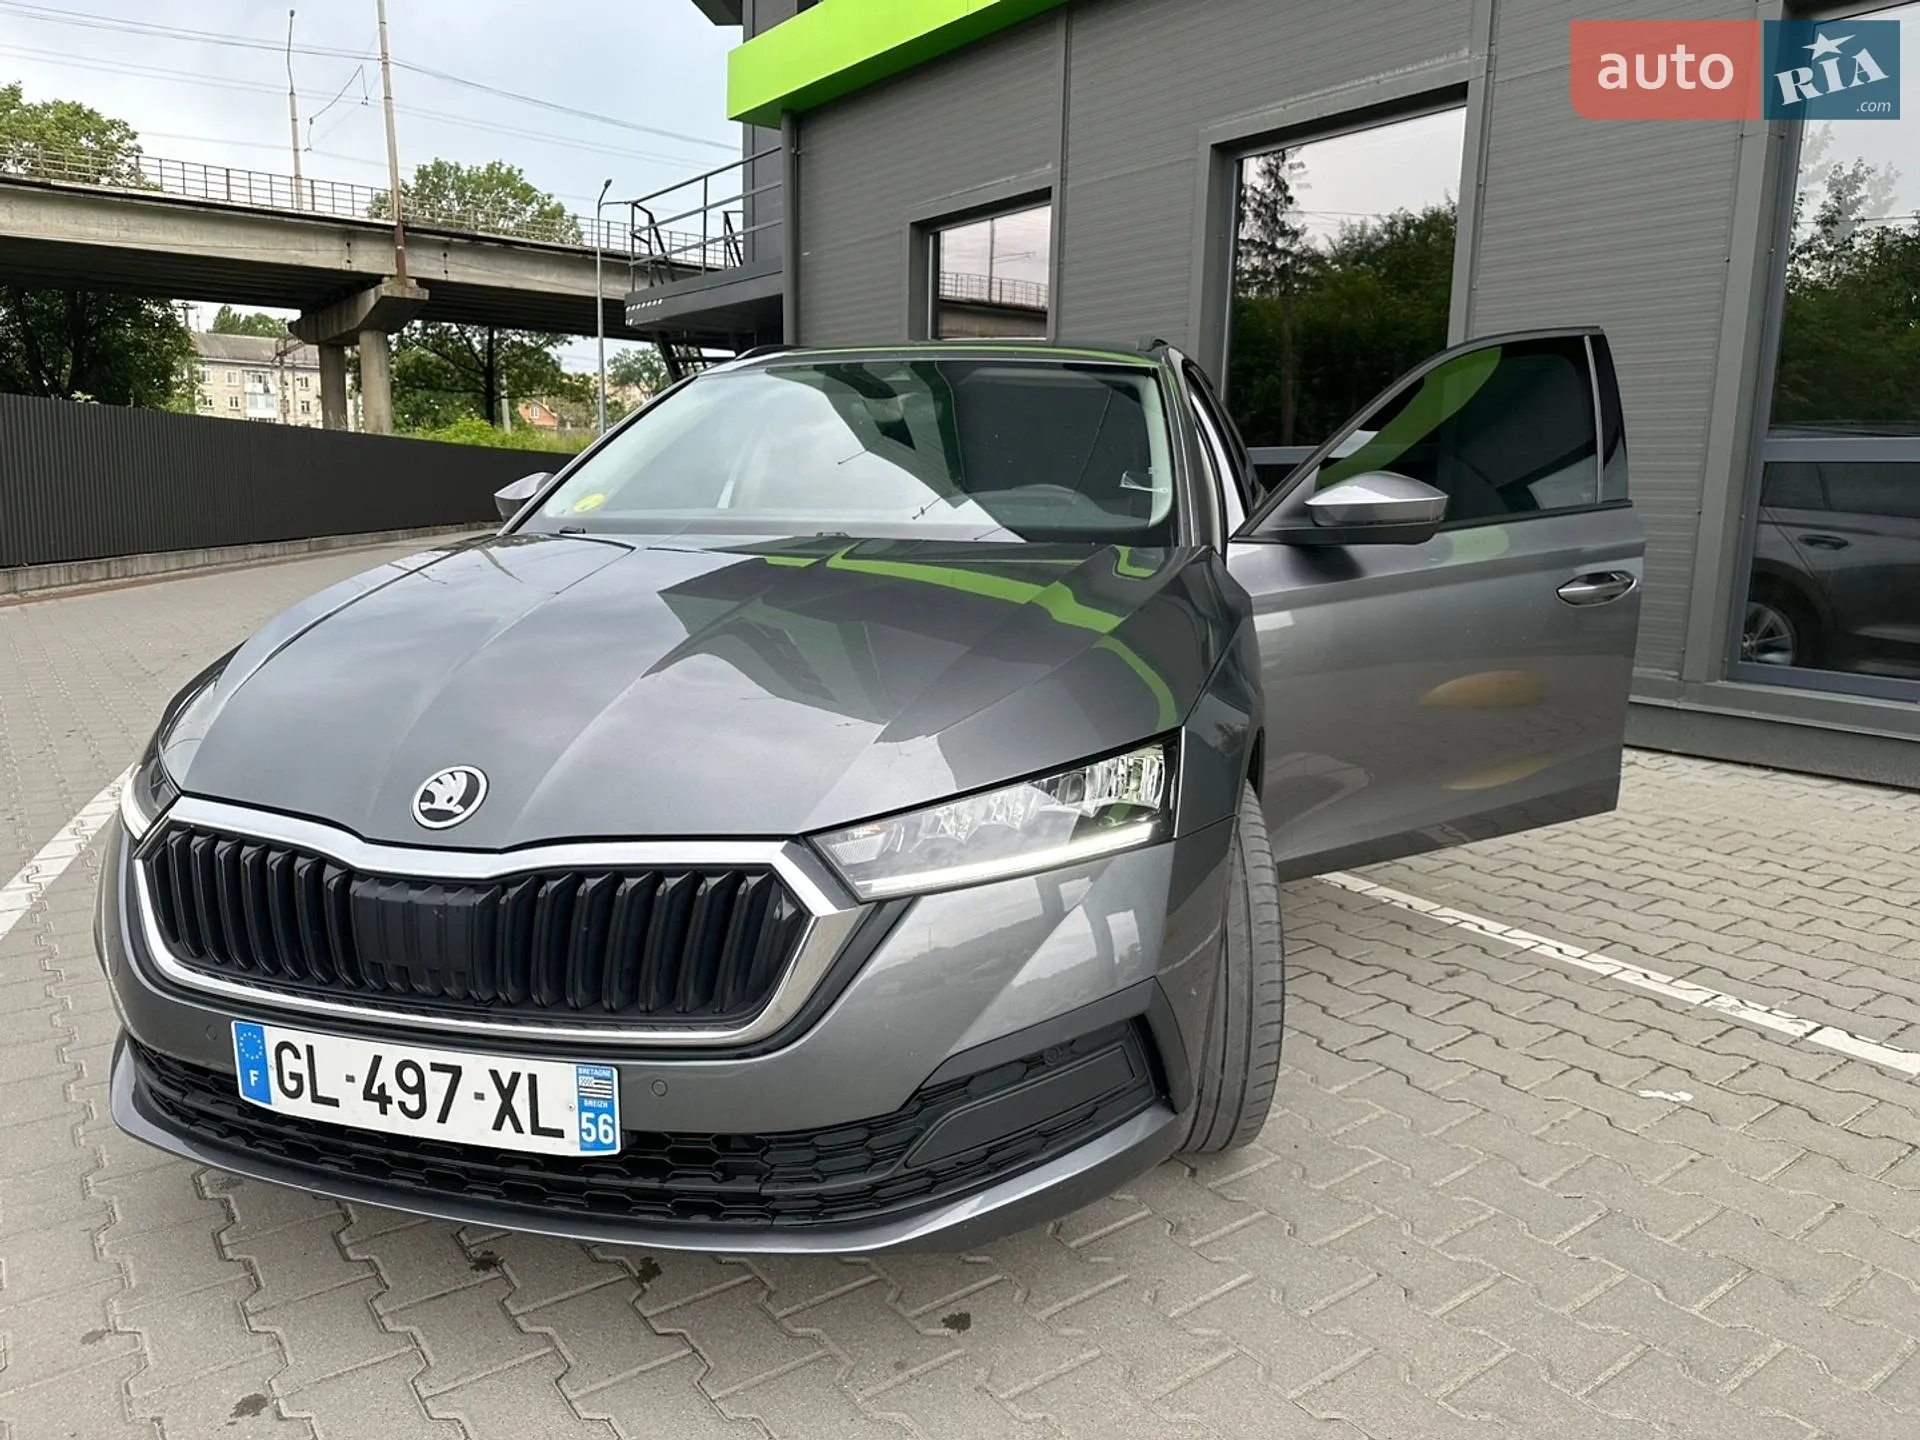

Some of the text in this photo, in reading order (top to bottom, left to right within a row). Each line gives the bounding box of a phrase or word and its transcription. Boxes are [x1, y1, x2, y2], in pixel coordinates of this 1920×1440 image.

[248, 1069, 259, 1088] F
[578, 1067, 612, 1077] BRETAGNE
[274, 1040, 565, 1139] GL-497-XL
[583, 1099, 609, 1109] BREIZH
[581, 1111, 614, 1144] 56
